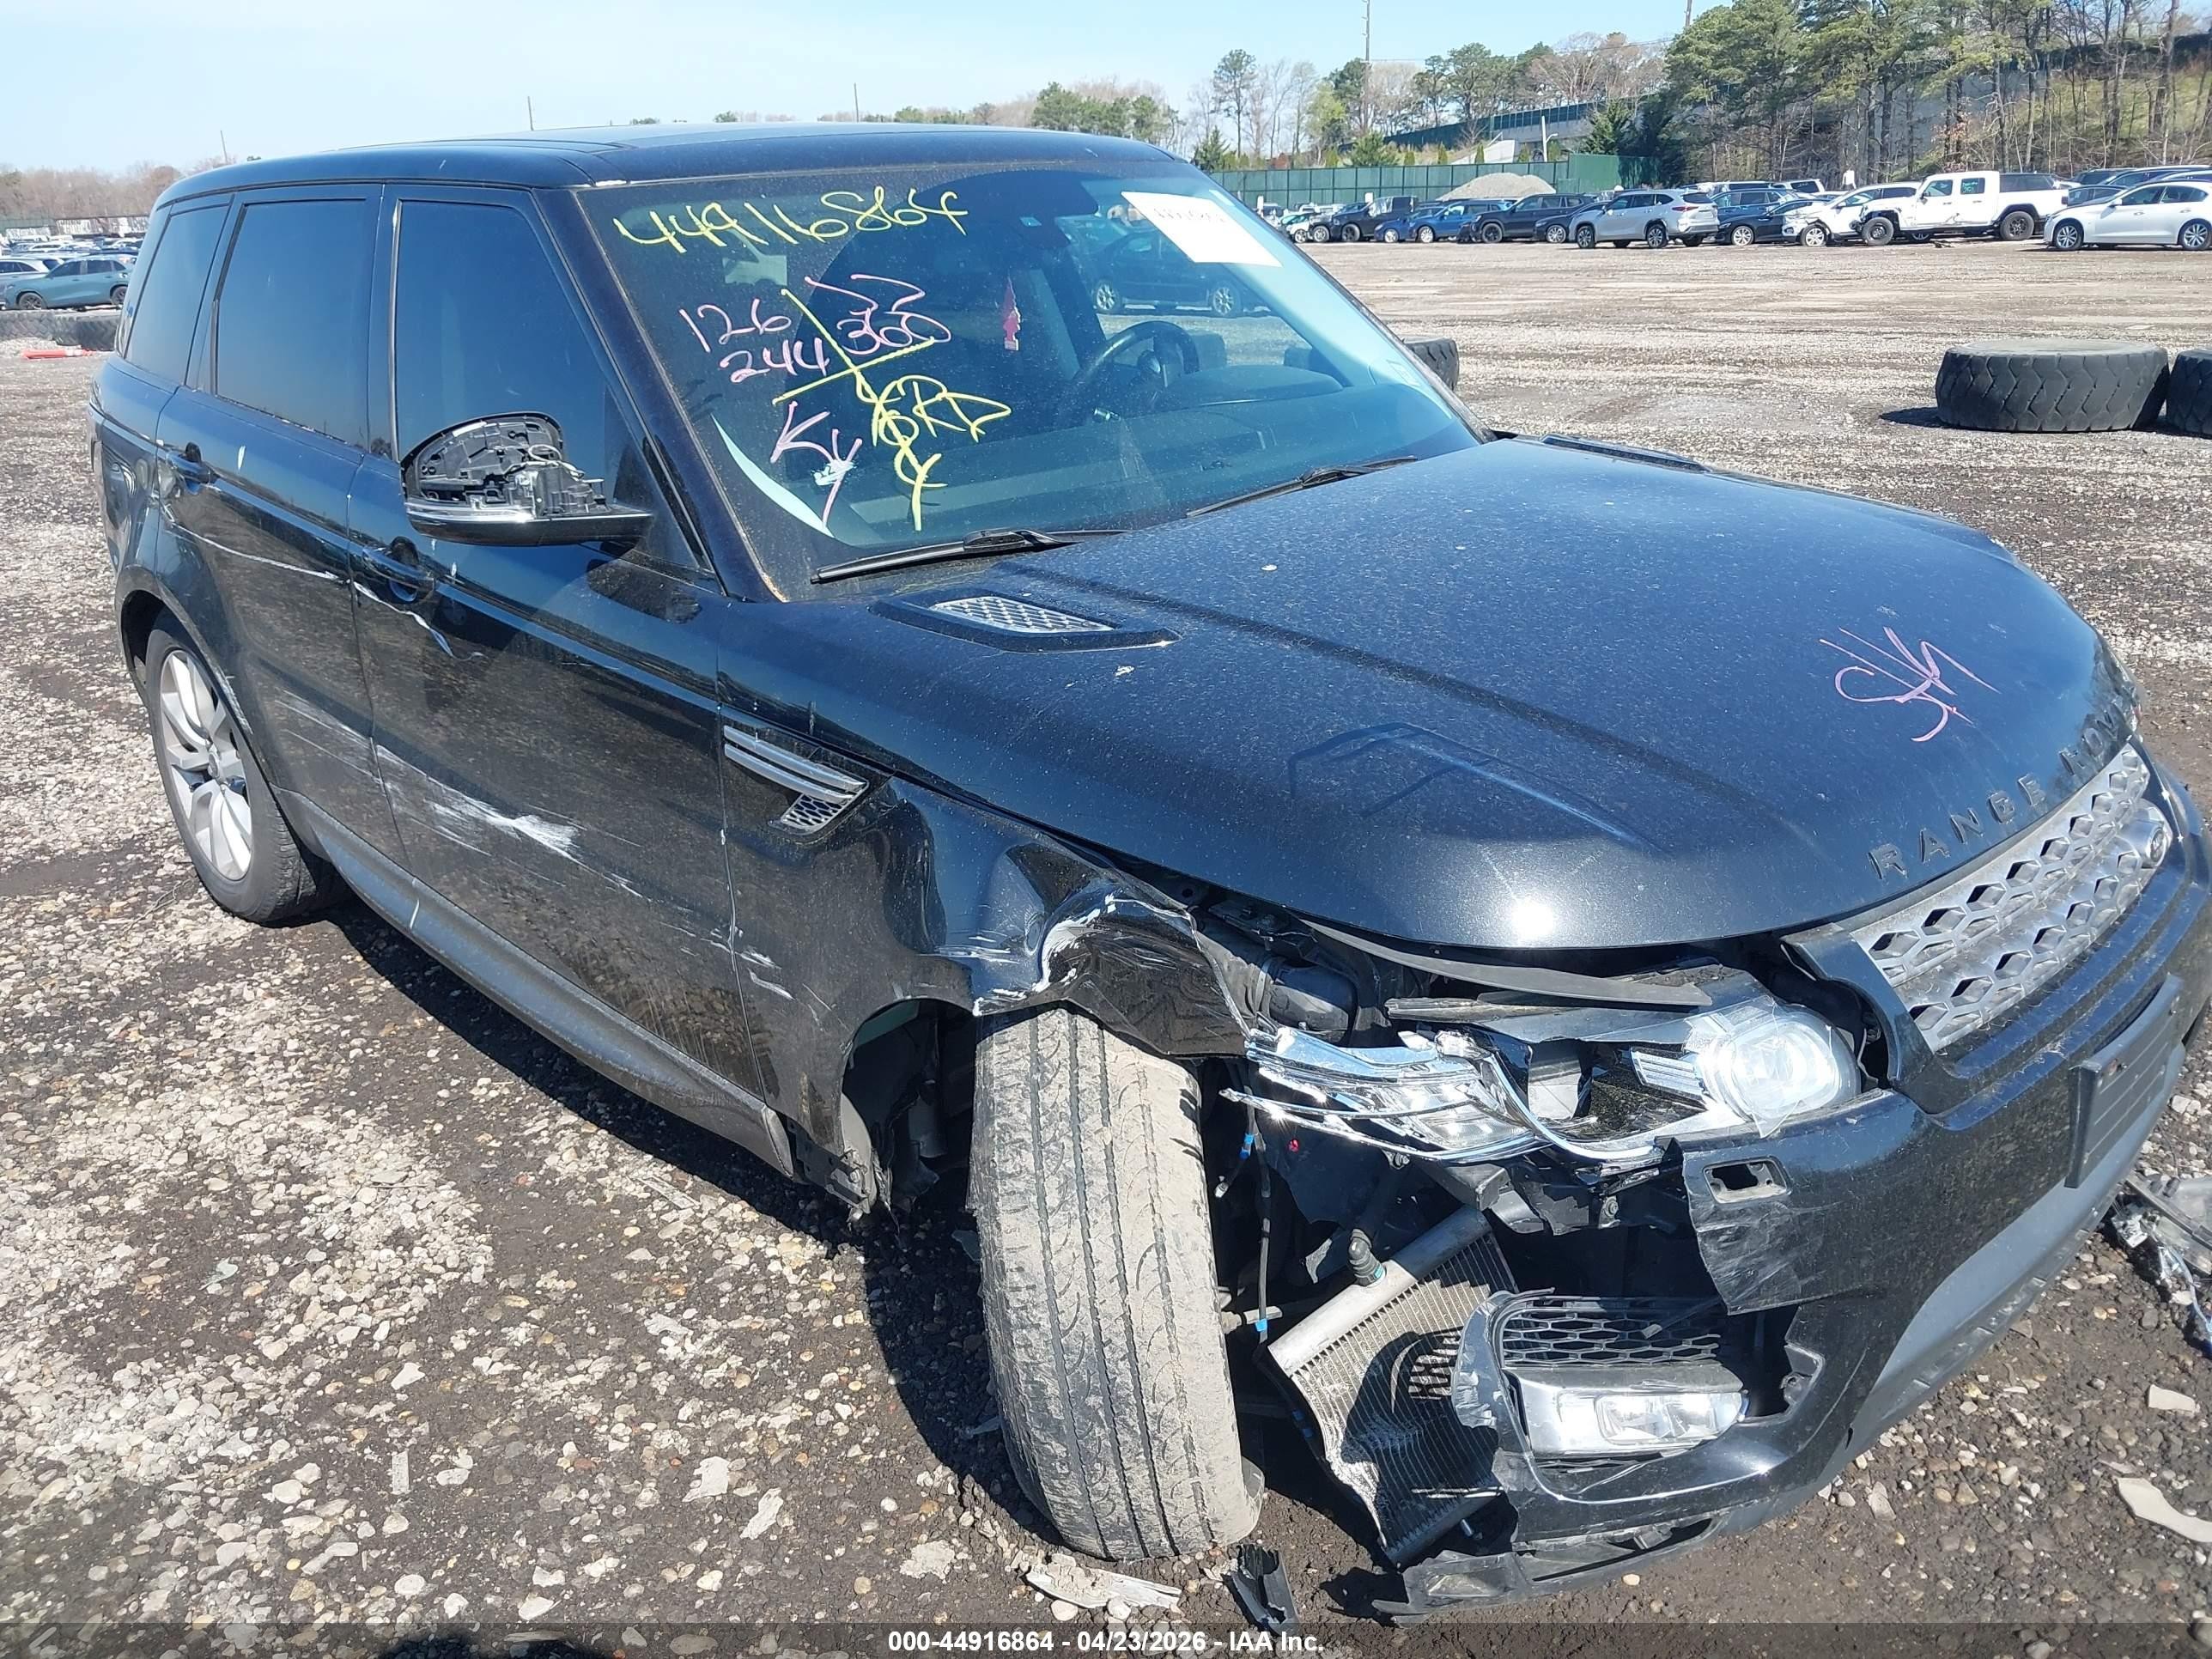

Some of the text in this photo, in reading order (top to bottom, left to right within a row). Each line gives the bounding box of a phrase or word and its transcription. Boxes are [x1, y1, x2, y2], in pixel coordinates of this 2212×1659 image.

[678, 298, 792, 354] 126
[719, 337, 831, 383] 244
[1867, 773, 2046, 884] RANGE
